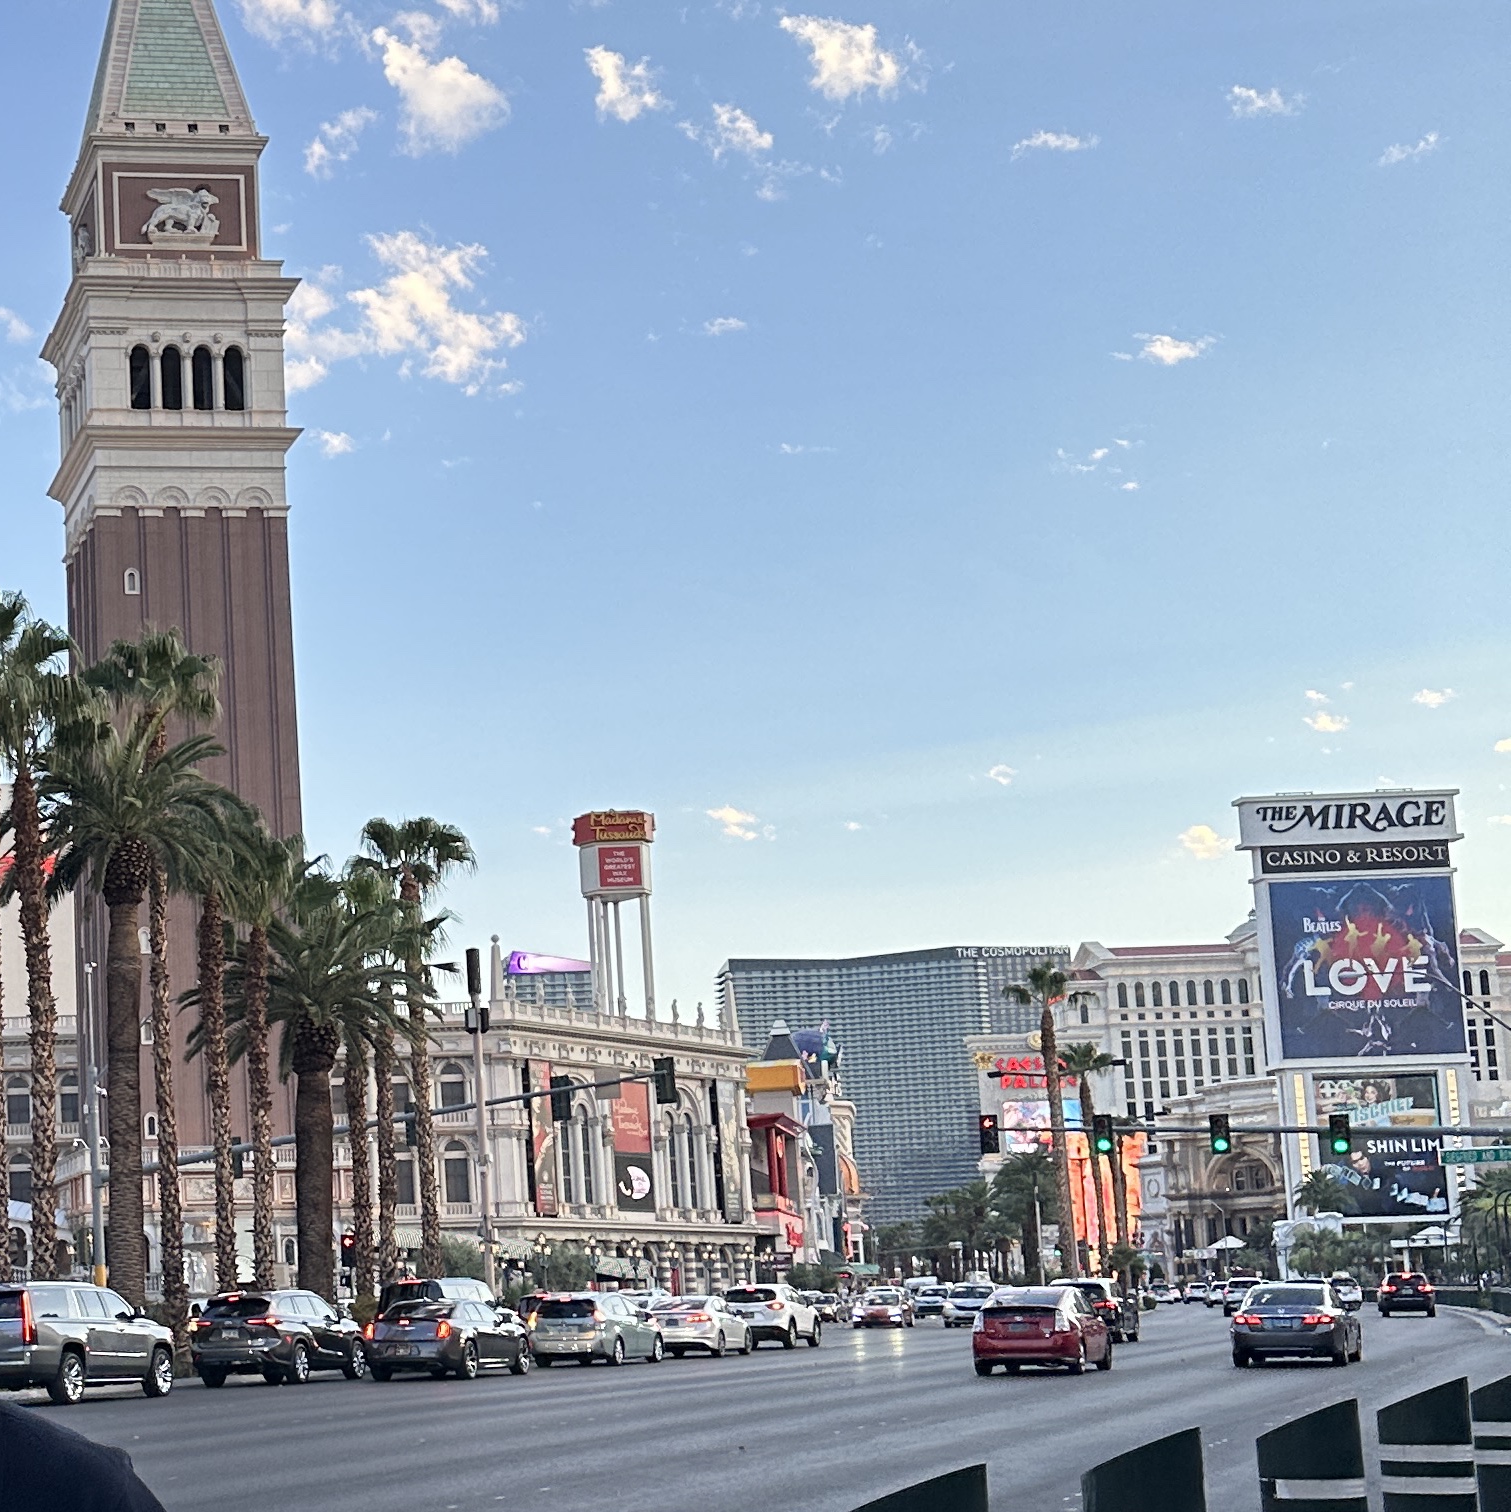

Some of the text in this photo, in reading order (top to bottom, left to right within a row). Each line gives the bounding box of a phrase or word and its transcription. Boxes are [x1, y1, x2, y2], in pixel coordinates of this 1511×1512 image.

[1256, 800, 1447, 833] THE MIRAGE
[1266, 846, 1447, 867] CASINO & RESORT
[956, 945, 1069, 958] THE COSMOPOLITAN
[1303, 955, 1432, 996] LOVE
[1328, 998, 1418, 1011] CIRQUE DU SOLEIL
[1367, 1138, 1440, 1154] SHIN LIM
